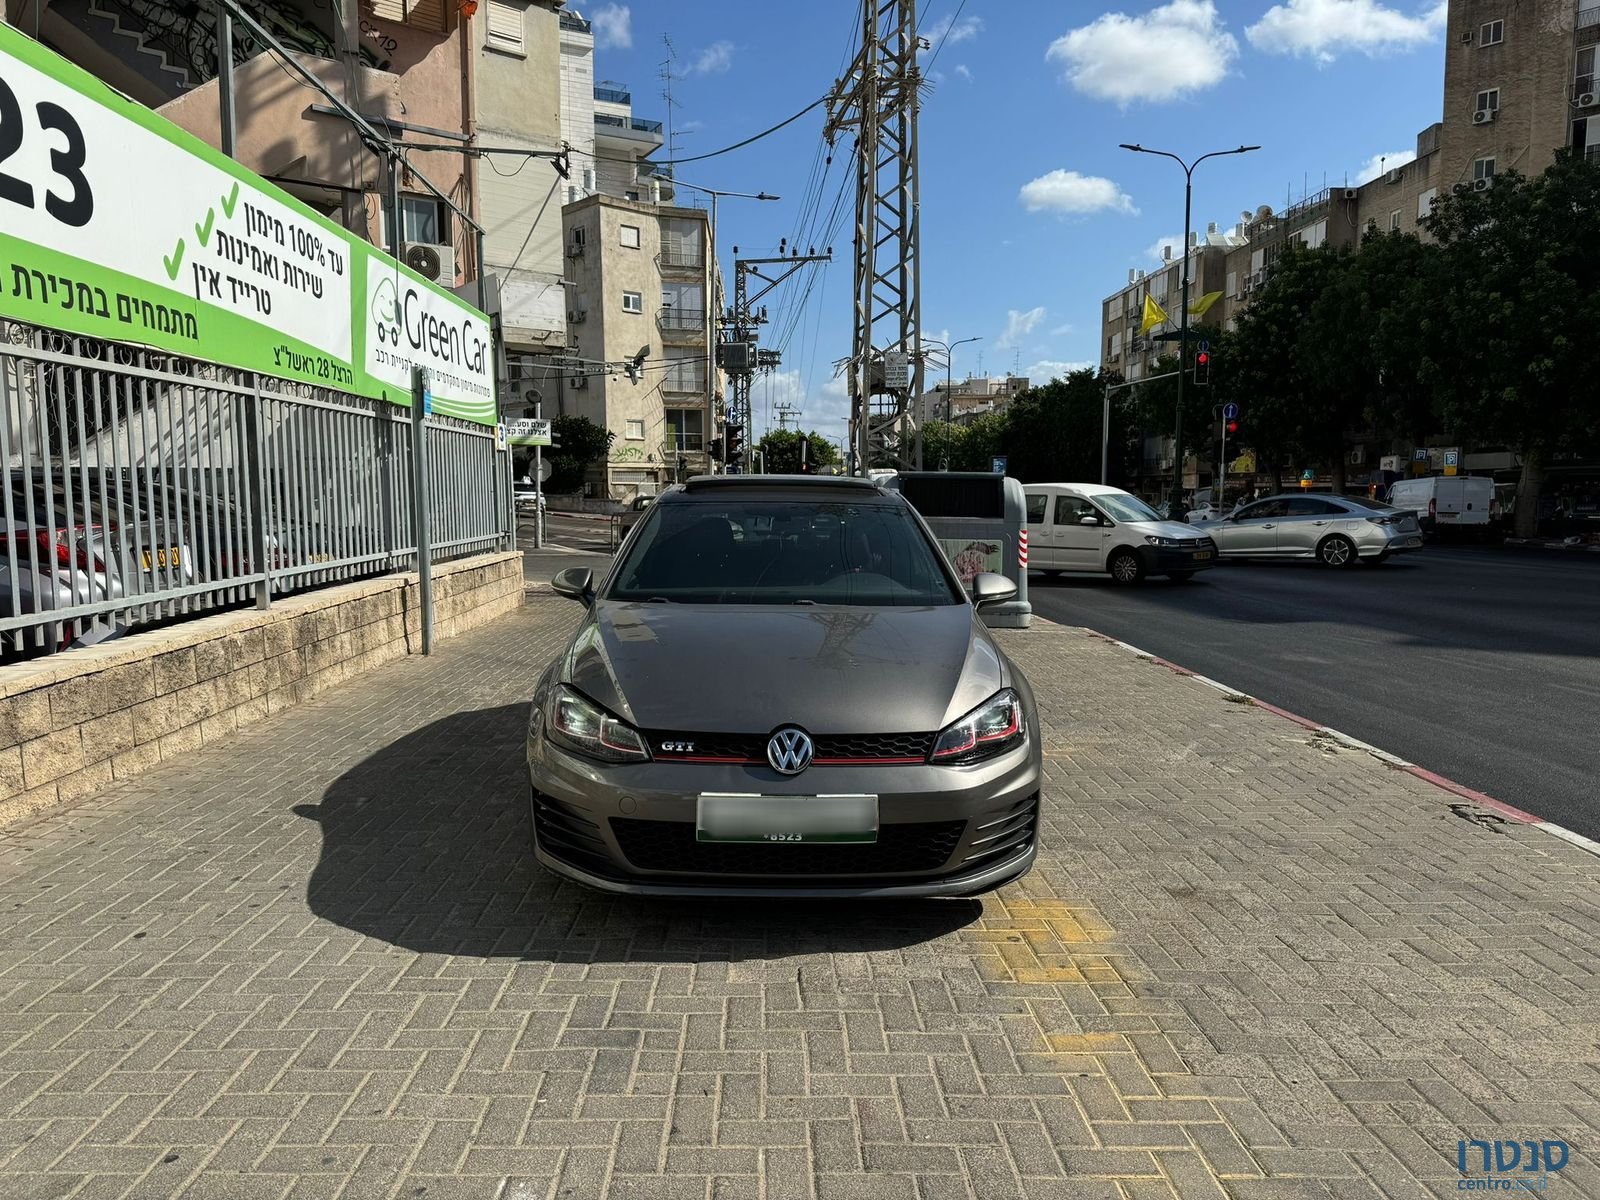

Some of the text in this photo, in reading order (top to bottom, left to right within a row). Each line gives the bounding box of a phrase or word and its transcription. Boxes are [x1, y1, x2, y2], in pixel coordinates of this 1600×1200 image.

[244, 202, 343, 276] עד 100% מימון
[216, 229, 323, 299] שירות ואמינות
[192, 262, 272, 315] טרייד אין
[11, 263, 199, 340] מתמחים במכירת
[404, 288, 487, 376] Green Car
[316, 356, 330, 379] 28
[375, 348, 390, 365] רכב
[391, 354, 412, 375] לקניית
[330, 360, 353, 385] הרצל
[528, 428, 547, 436] אצלנו
[661, 741, 695, 752] GTI
